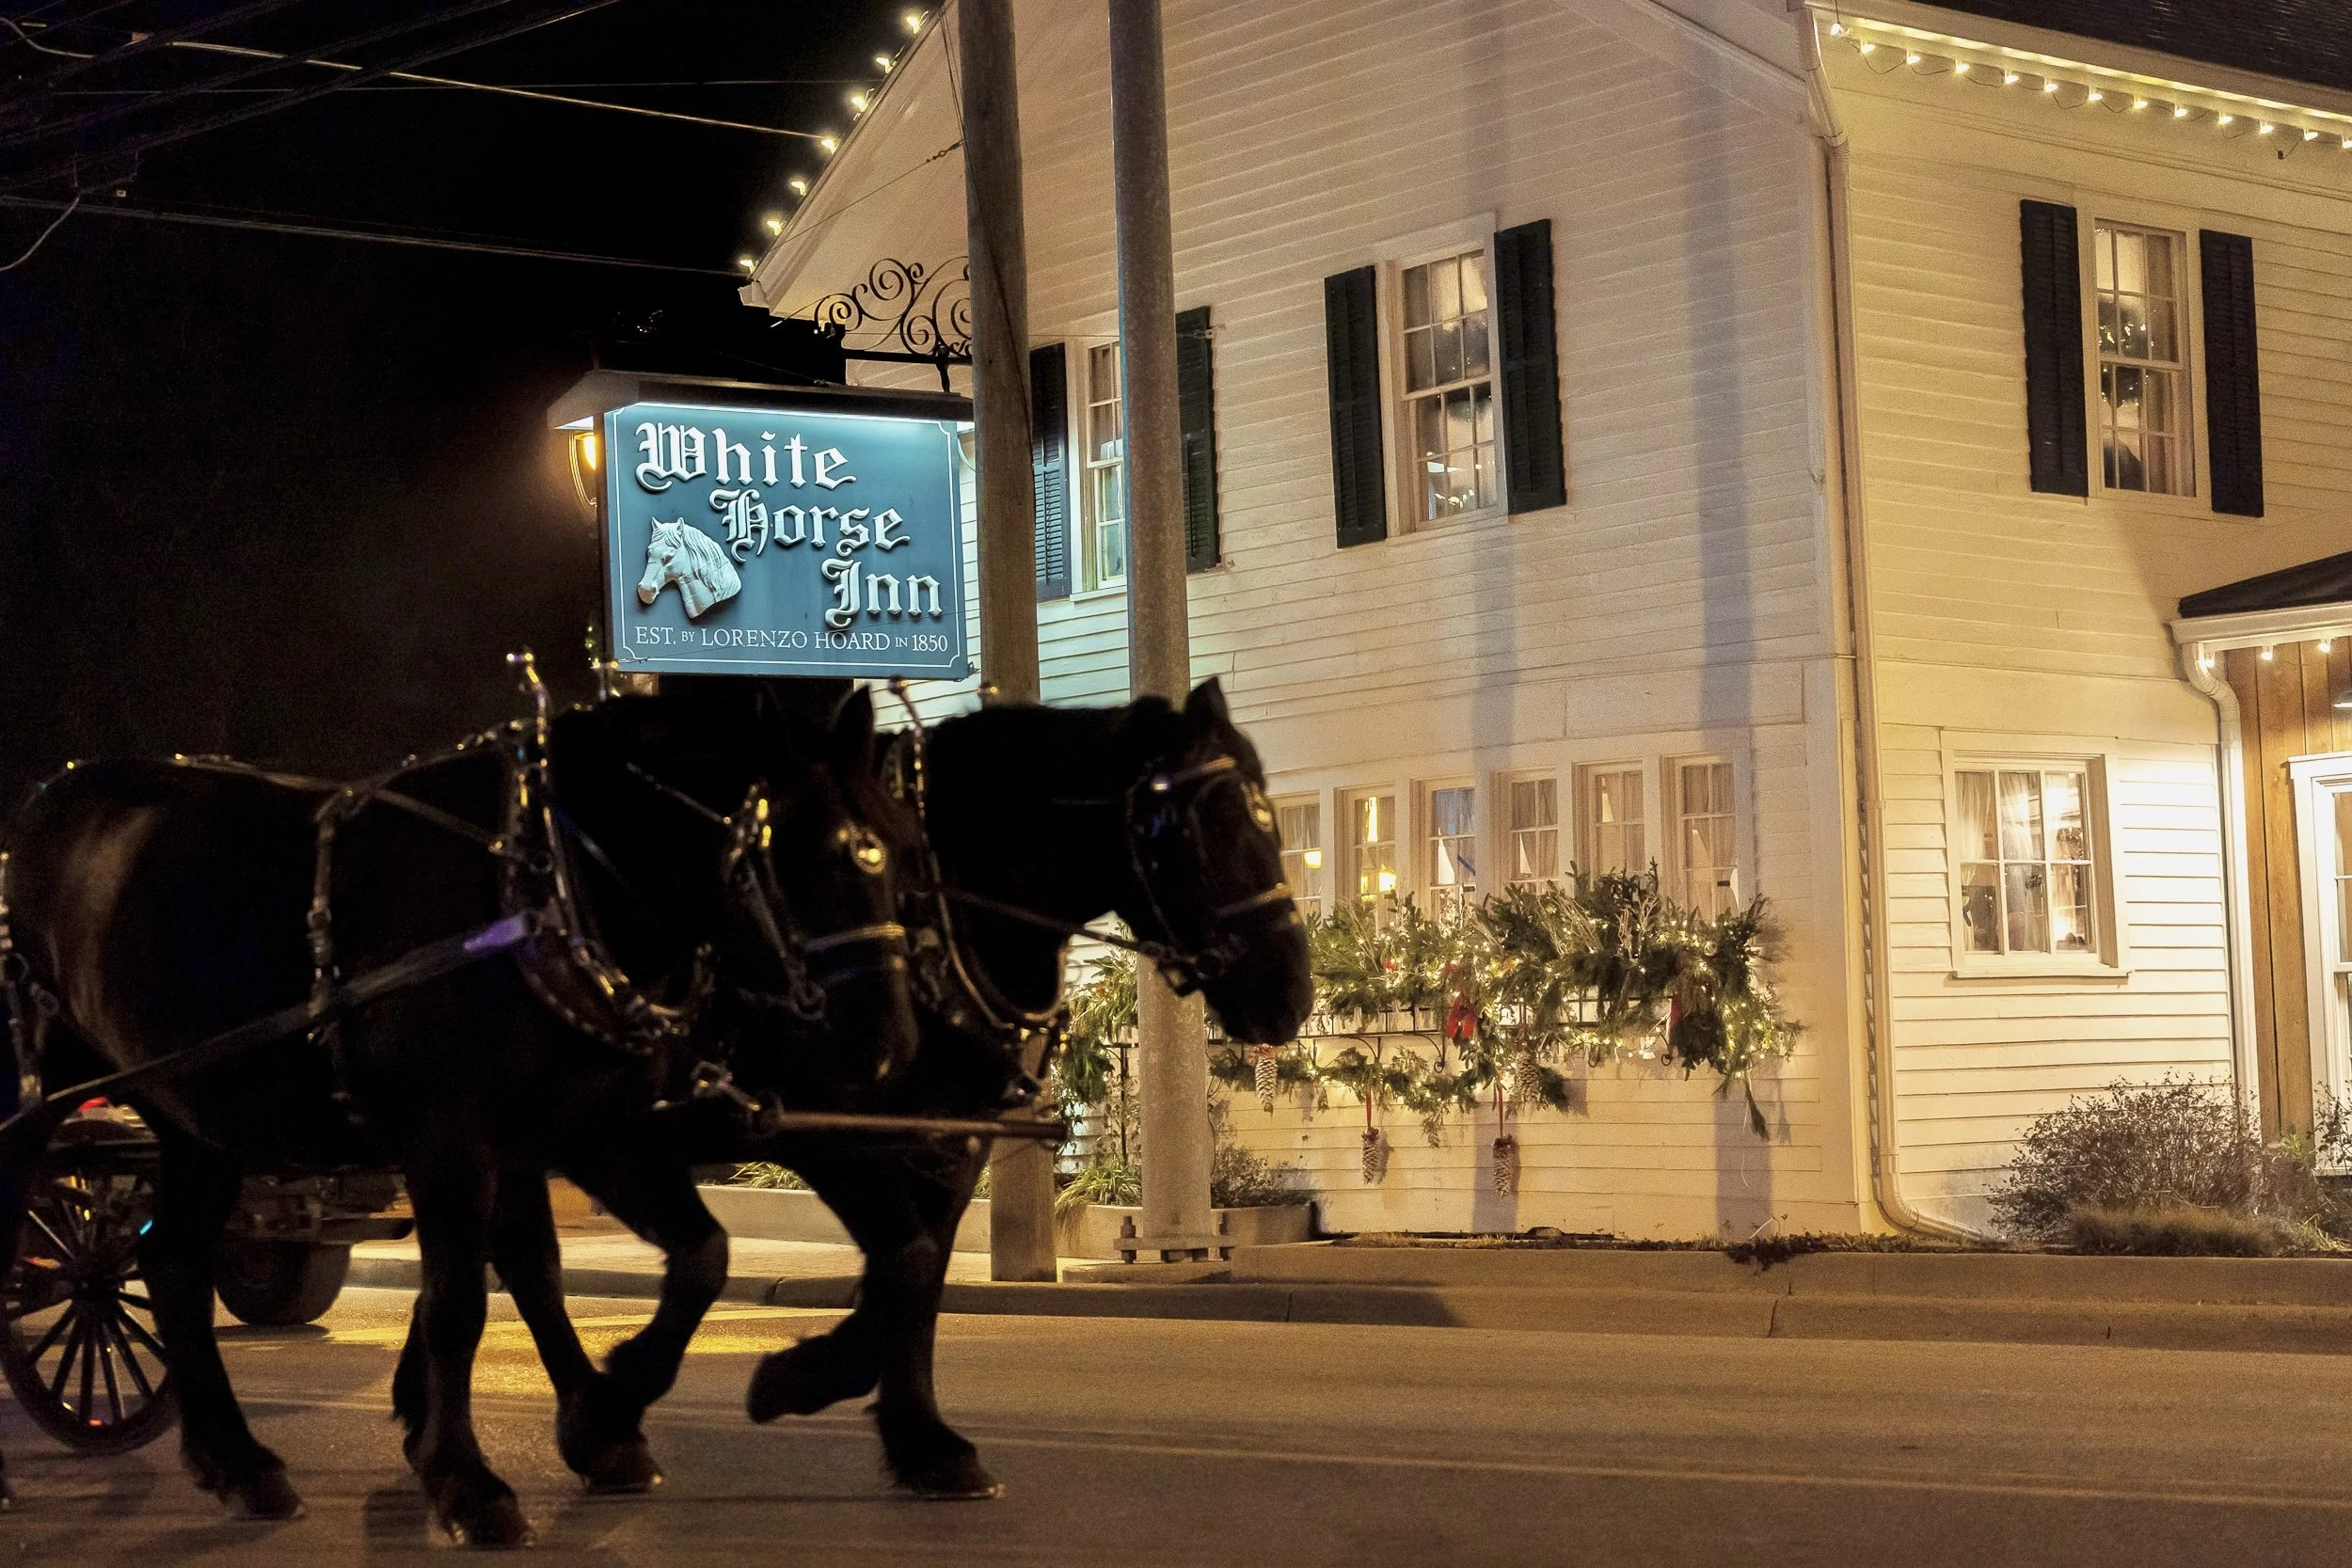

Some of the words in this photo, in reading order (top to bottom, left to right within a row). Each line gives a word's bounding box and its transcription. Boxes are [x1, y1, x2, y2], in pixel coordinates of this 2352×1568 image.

[635, 420, 857, 492] White
[708, 488, 911, 562] Horse
[821, 558, 944, 628] Inn
[635, 626, 676, 644] EST.
[681, 631, 695, 641] BY
[701, 628, 808, 648] LORENZO
[814, 631, 890, 650] HOARD
[896, 638, 908, 647] IN
[912, 634, 947, 652] 1850
